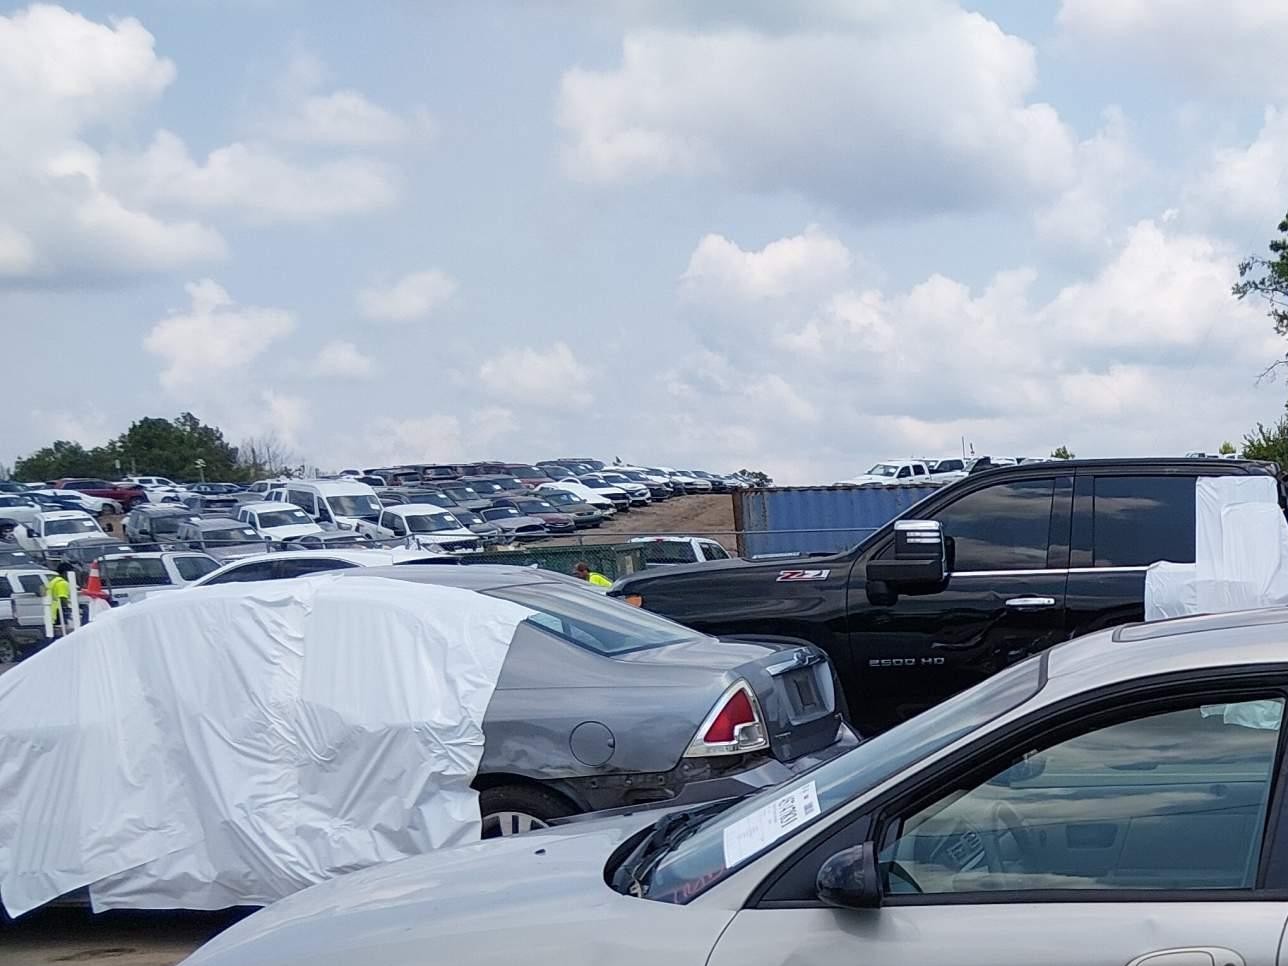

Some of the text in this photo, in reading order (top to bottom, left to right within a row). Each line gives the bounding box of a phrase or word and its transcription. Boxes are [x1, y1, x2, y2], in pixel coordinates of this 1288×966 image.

[776, 569, 831, 582] Z71
[869, 657, 945, 667] 2500 HD
